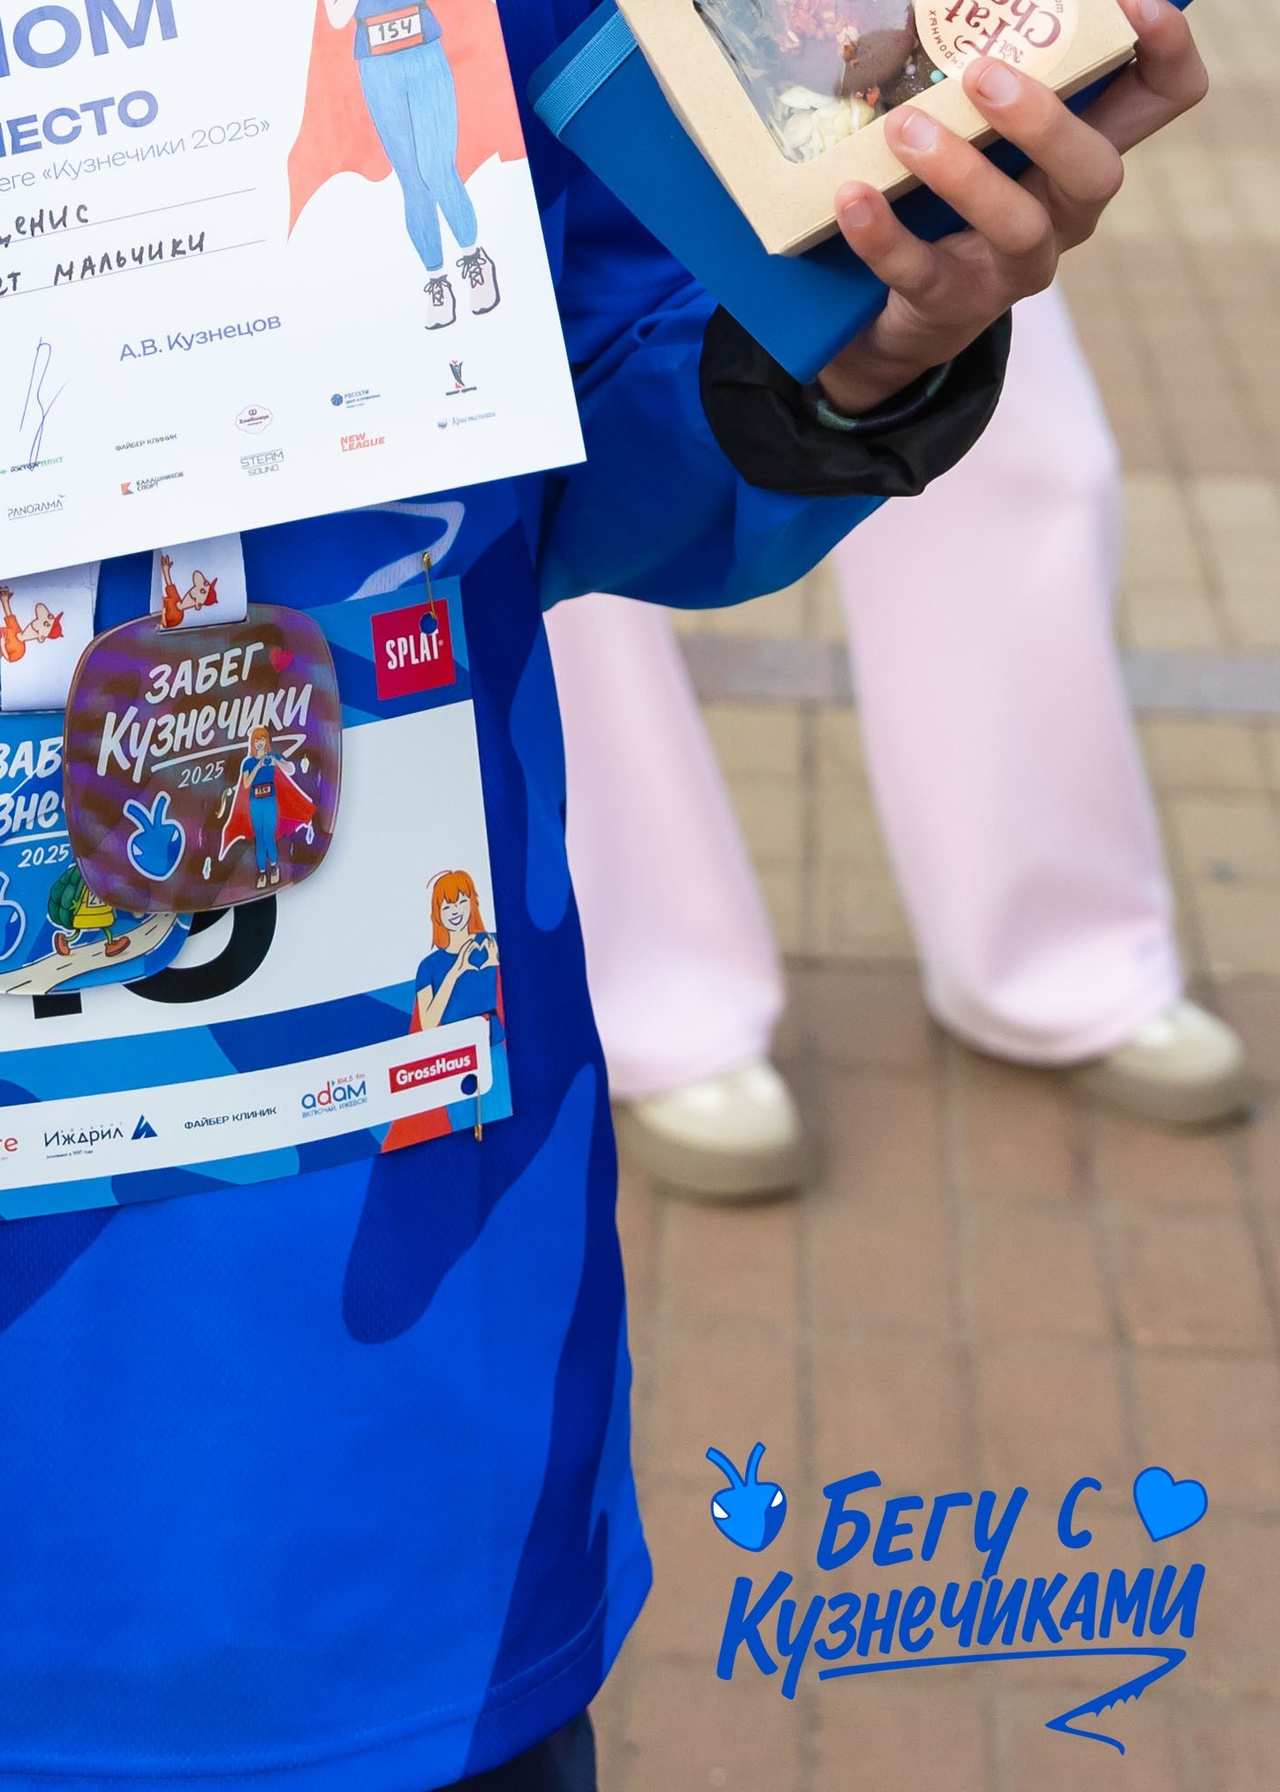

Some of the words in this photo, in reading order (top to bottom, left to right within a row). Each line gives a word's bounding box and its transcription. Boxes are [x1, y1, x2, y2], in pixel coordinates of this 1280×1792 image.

[378, 18, 412, 42] 154
[42, 138, 185, 181] «Кузнечики
[190, 116, 271, 151] 2025»
[119, 338, 163, 361] А.В.
[166, 315, 282, 351] Кузнецов
[342, 436, 386, 452] LEAGUE
[144, 642, 264, 705] ЗАБЕГ
[96, 683, 313, 783] Кузнечики
[177, 760, 224, 789] 2025
[17, 844, 71, 869] 2025
[395, 1054, 472, 1085] GrossHaus
[184, 1115, 230, 1130] ФАЙБЕР
[232, 1107, 277, 1122] КЛИНИК
